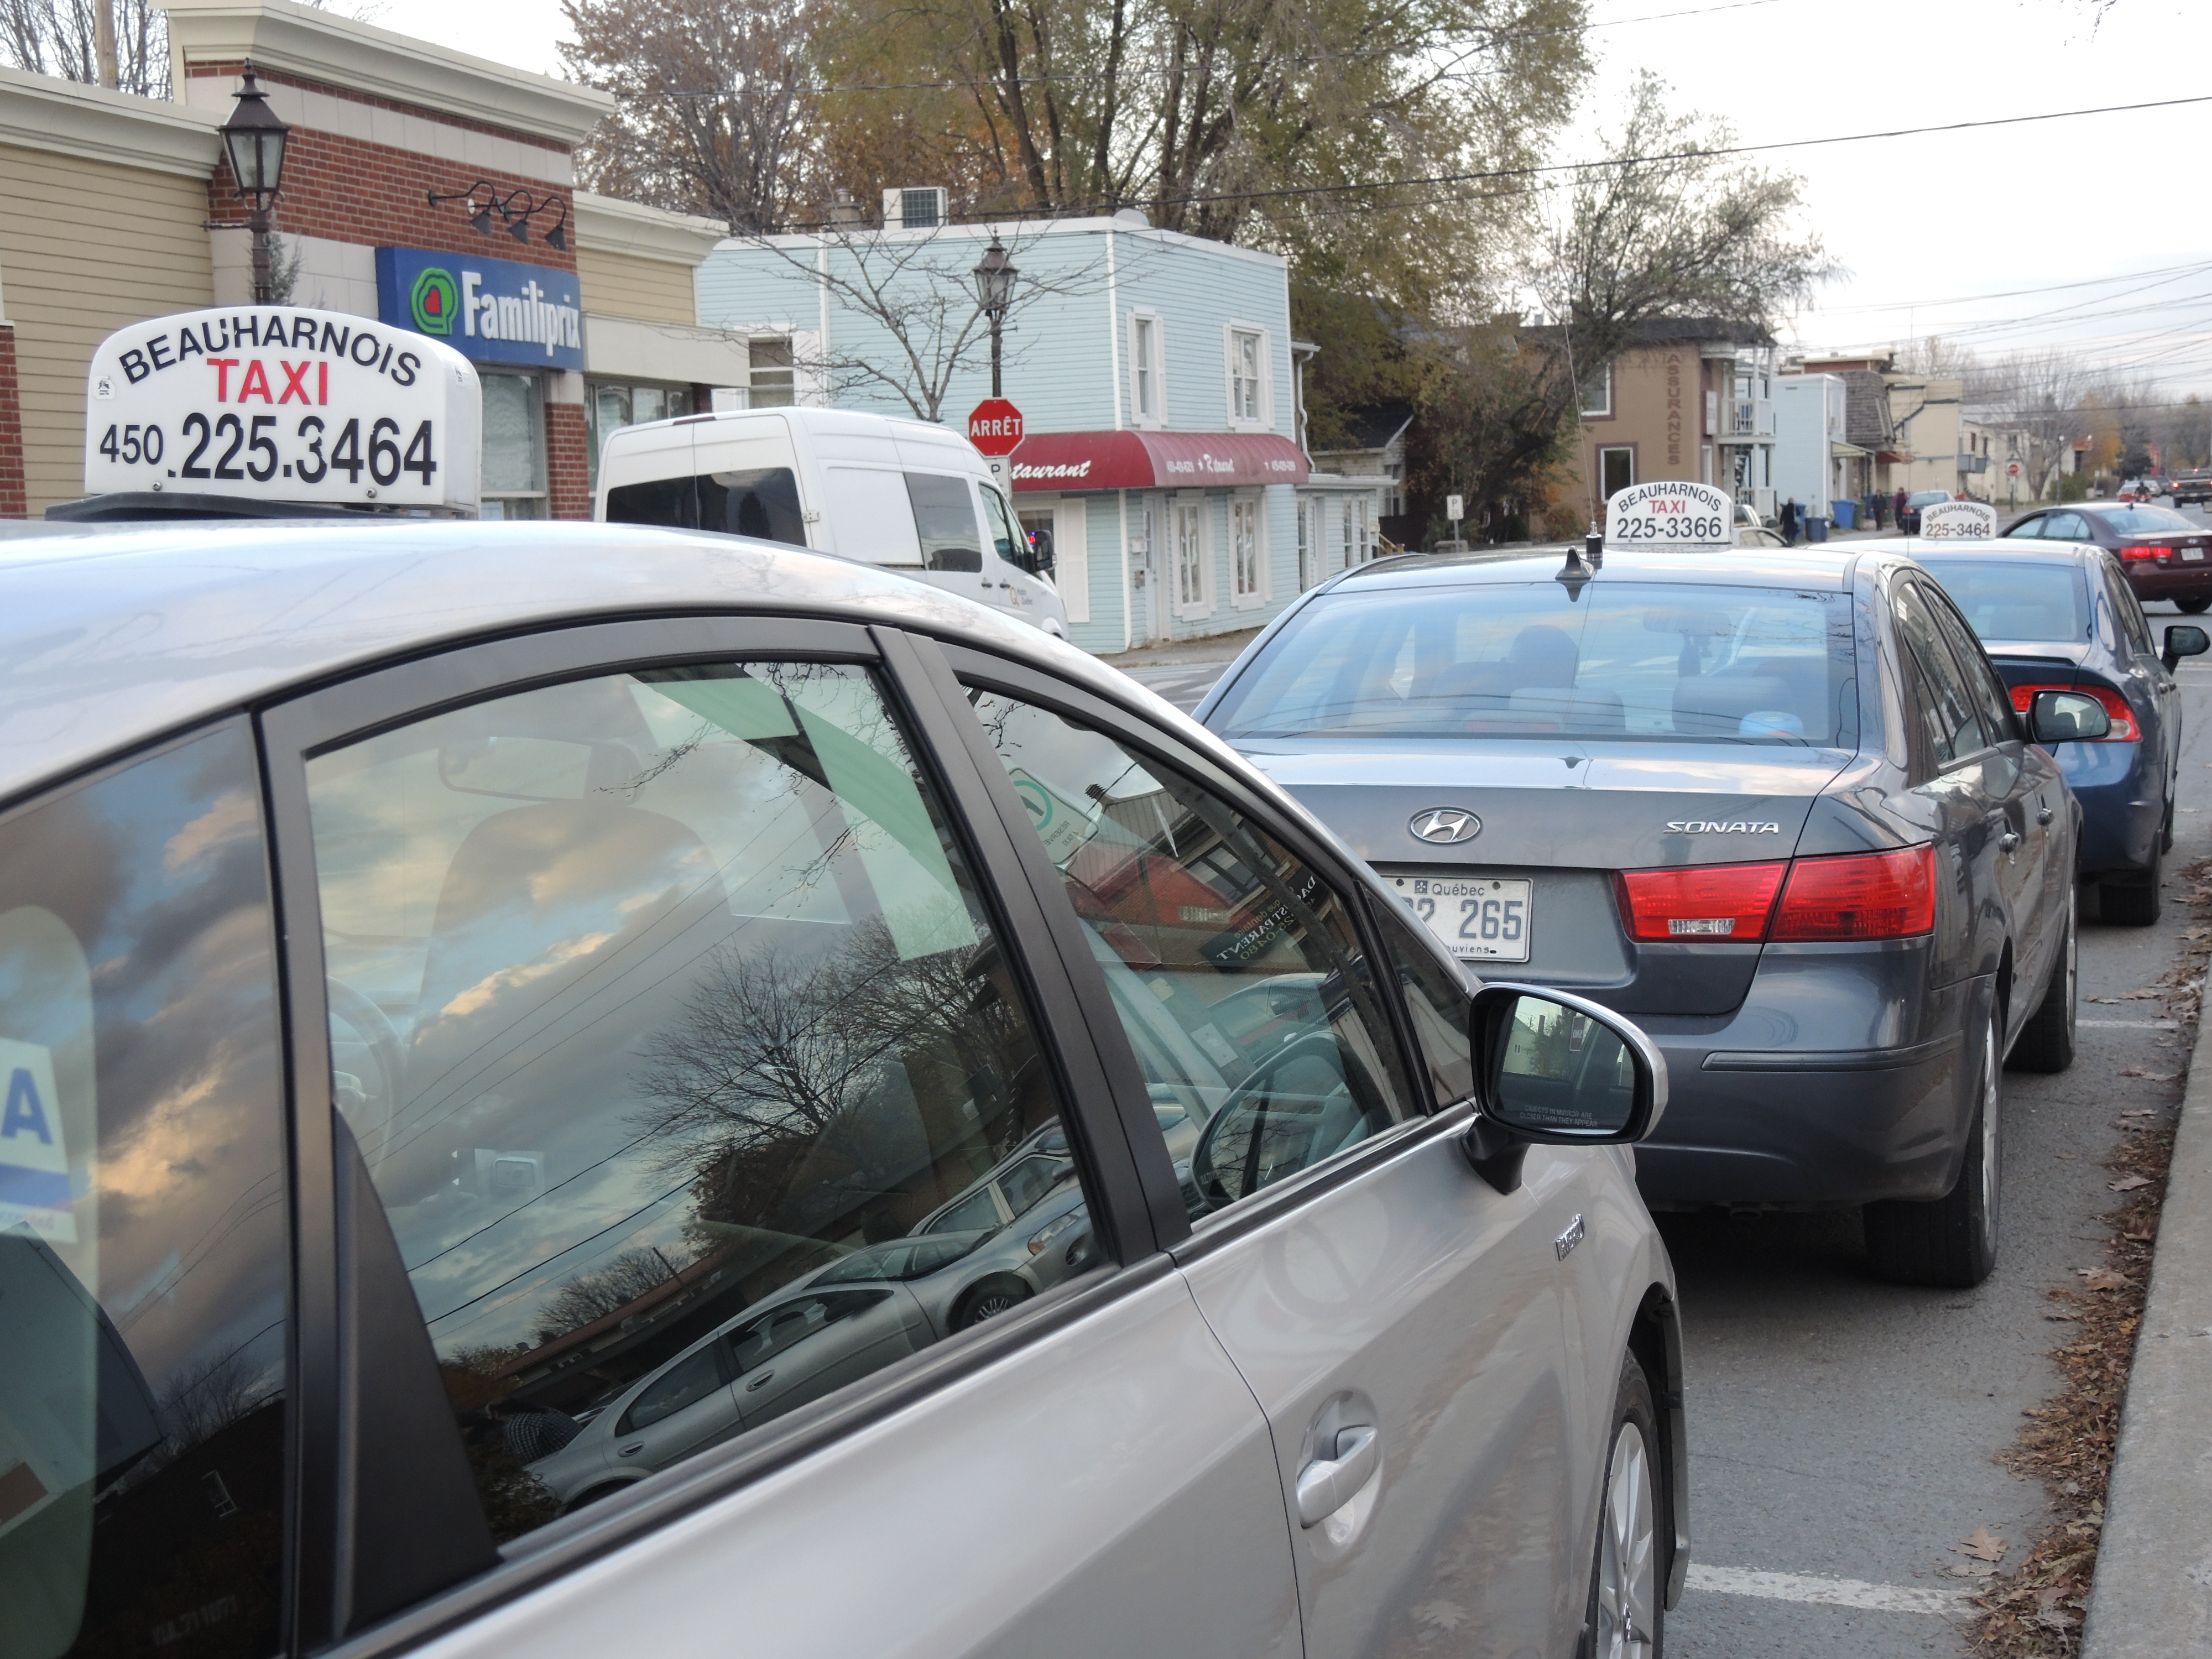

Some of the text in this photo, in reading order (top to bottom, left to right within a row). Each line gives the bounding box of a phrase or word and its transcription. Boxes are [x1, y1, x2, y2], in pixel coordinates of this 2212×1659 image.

[462, 271, 581, 357] Familiprix
[119, 315, 421, 387] BEAUHARNOIS
[207, 358, 327, 405] TAXI
[1667, 353, 1682, 465] ASSURANCES
[971, 416, 1021, 437] ARRÊT
[1618, 483, 1721, 513] BEAUHARNOIS
[1648, 500, 1686, 514] TAXI
[1926, 504, 1990, 521] BEAUHARNOIS
[1616, 517, 1721, 539] 225-3366
[1926, 523, 1990, 536] 225-3464
[1663, 821, 1778, 834] SONATA
[1432, 883, 1485, 896] Québec
[1459, 899, 1523, 940] 265
[1520, 1112, 1541, 1120] CLOSER
[1542, 1114, 1557, 1123] THAN
[1574, 1119, 1598, 1127] APPEAR
[1525, 1105, 1548, 1114] OBJECTS
